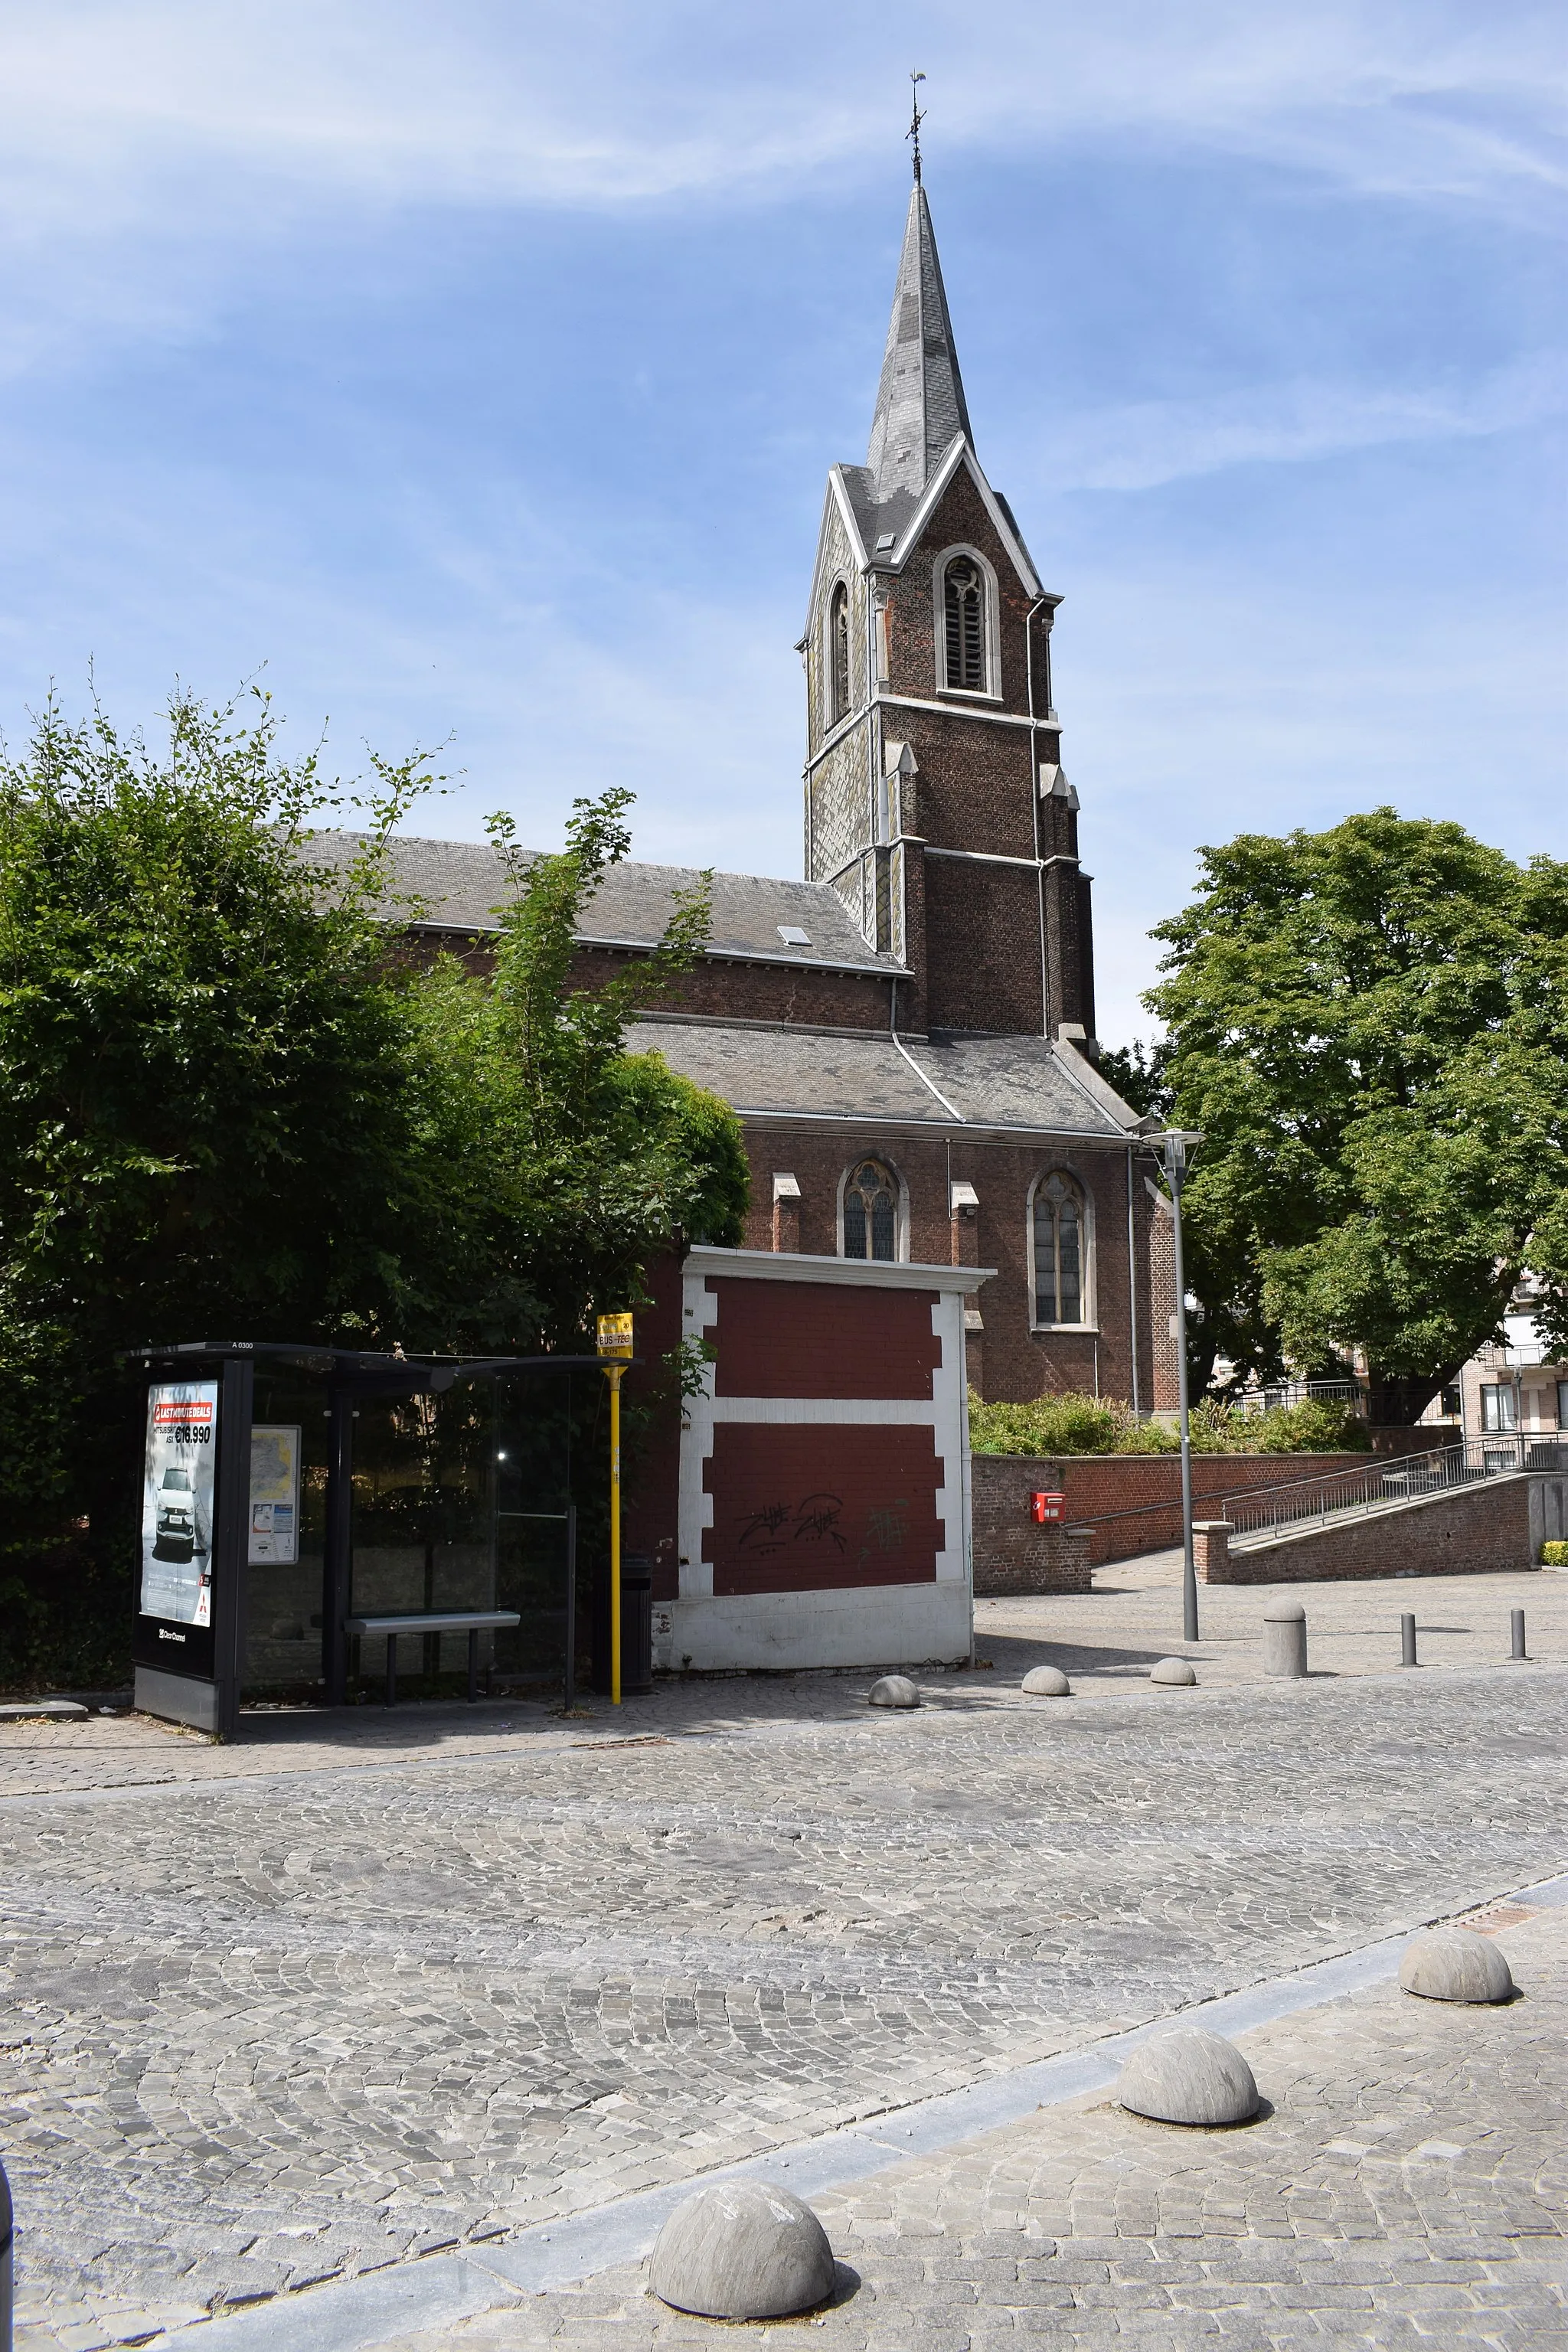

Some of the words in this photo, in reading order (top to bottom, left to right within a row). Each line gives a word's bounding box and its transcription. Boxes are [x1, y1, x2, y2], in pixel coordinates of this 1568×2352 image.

[599, 1336, 612, 1344] BUS
[617, 1334, 630, 1343] TEC
[161, 1408, 173, 1419] LAST
[193, 1407, 211, 1417] DEALS
[175, 1426, 211, 1444] €16.990
